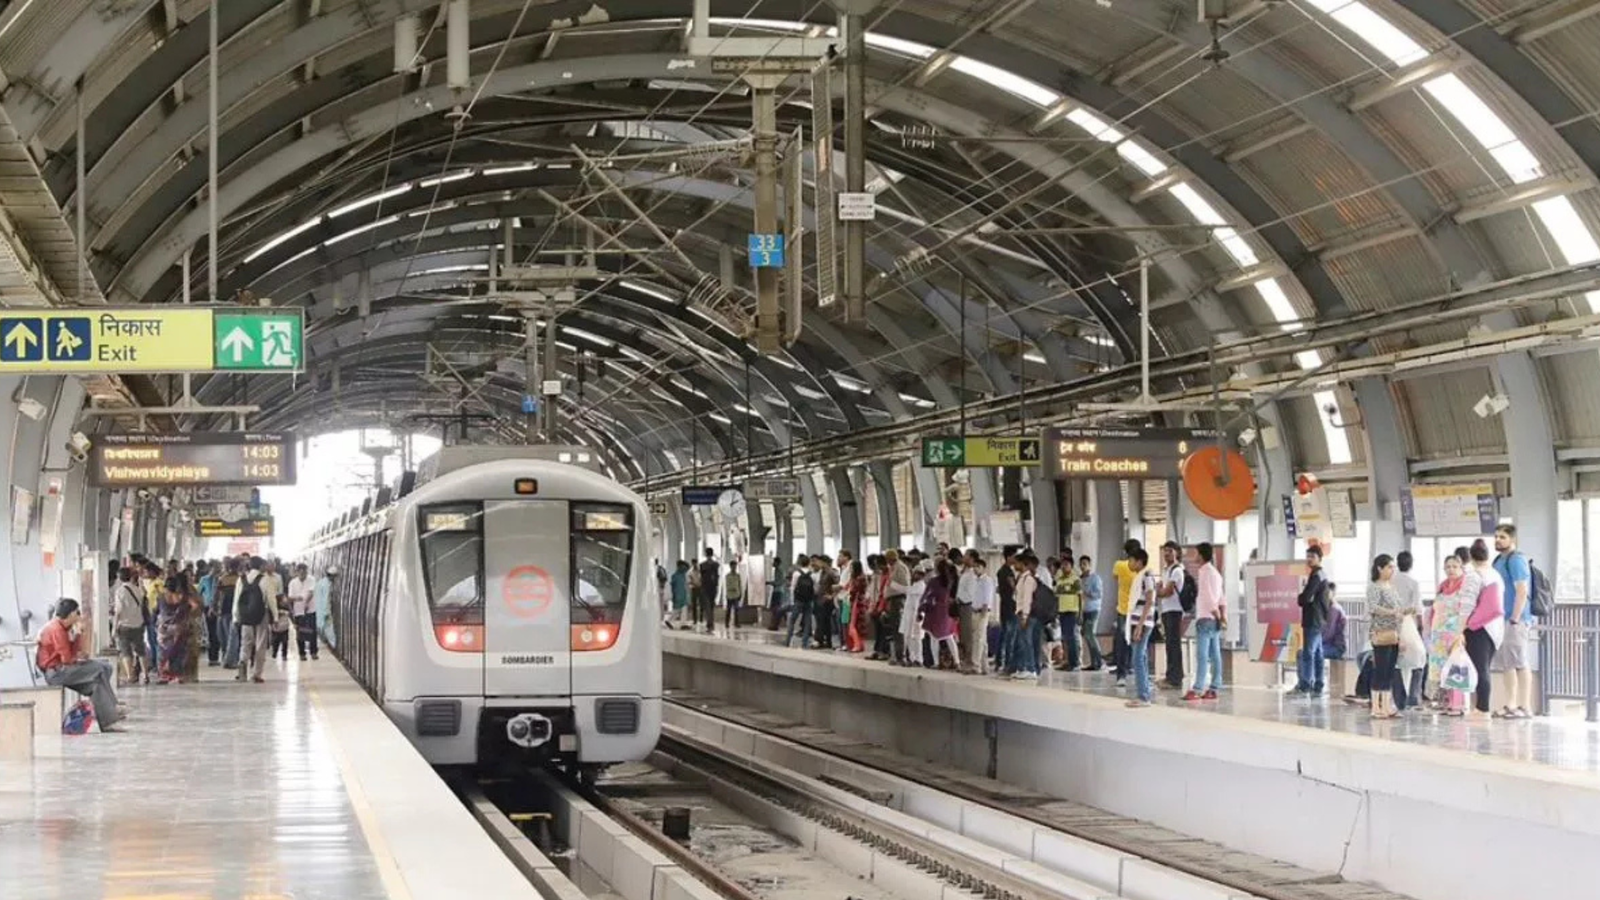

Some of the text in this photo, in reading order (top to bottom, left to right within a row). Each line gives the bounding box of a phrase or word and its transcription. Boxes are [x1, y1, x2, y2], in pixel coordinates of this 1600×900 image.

[757, 235, 775, 250] 33
[761, 251, 770, 265] 3
[98, 313, 163, 337] निकास
[98, 344, 137, 362] Exit
[243, 446, 279, 458] 14:03
[998, 453, 1016, 462] Exit
[243, 465, 279, 477] 14:03
[1060, 458, 1148, 471] Train Coaches
[104, 465, 209, 481] Vishwavidyalaya
[502, 655, 554, 664] BOMBARDIER
